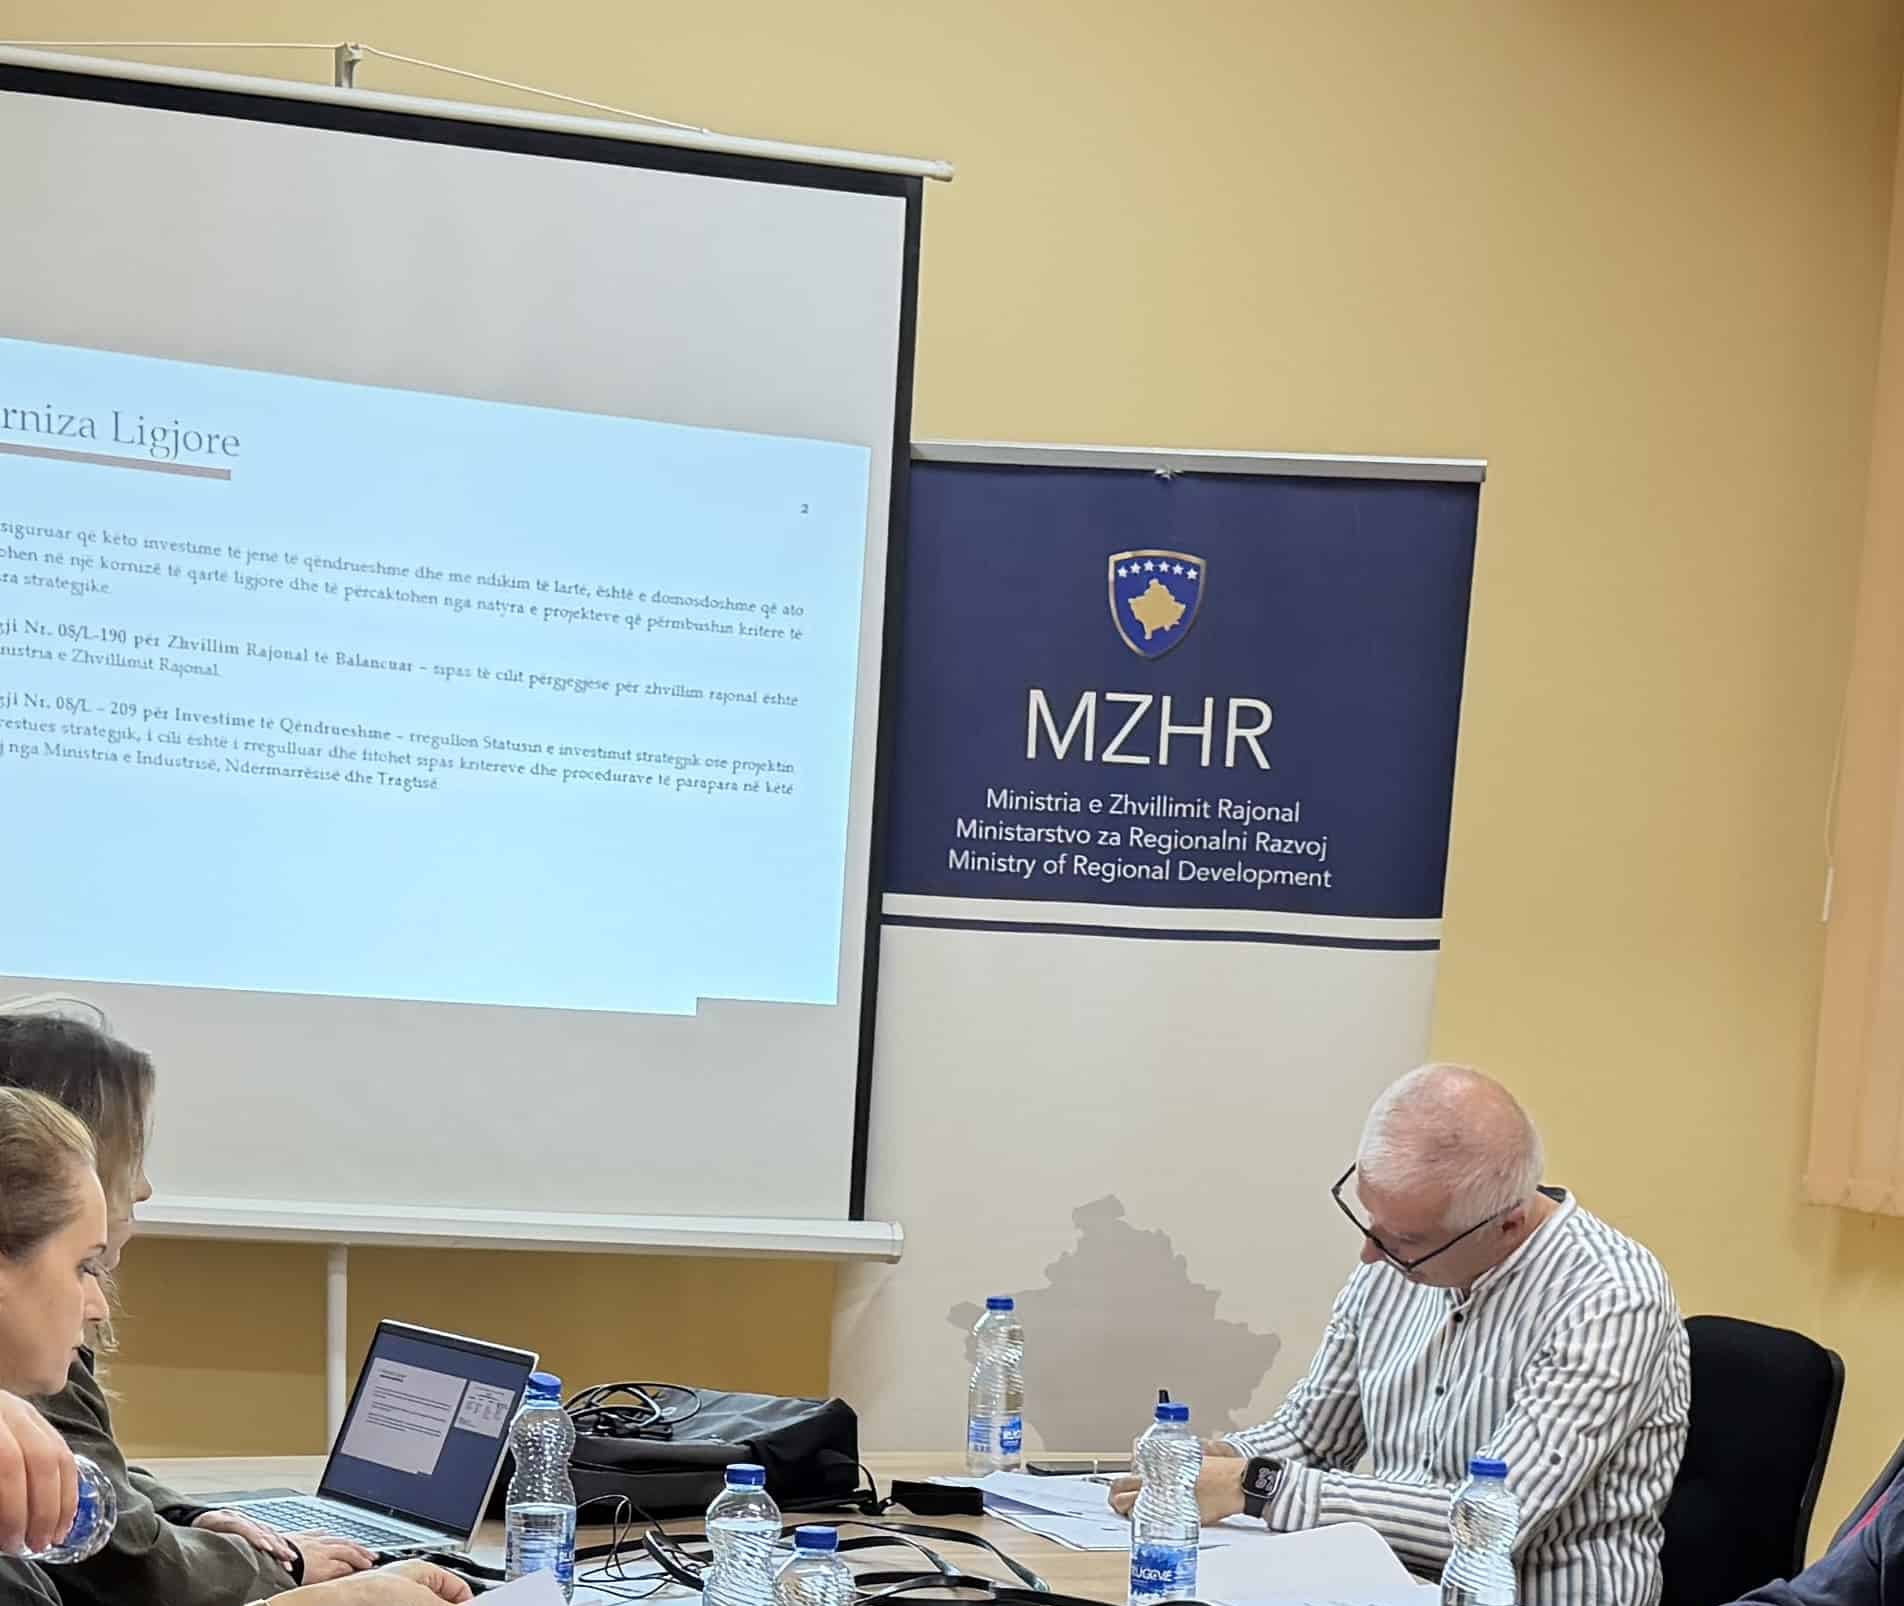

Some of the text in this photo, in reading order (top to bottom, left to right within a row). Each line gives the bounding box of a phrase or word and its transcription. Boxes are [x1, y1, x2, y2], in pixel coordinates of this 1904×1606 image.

[112, 410, 240, 457] Ligjore
[1025, 688, 1274, 770] MZHR
[986, 787, 1300, 826] Ministria e Zhvillimit Rajonal
[956, 816, 1328, 861] Ministarstvo za Regionalni Razvoj
[948, 847, 1333, 890] Ministry of Regional Development
